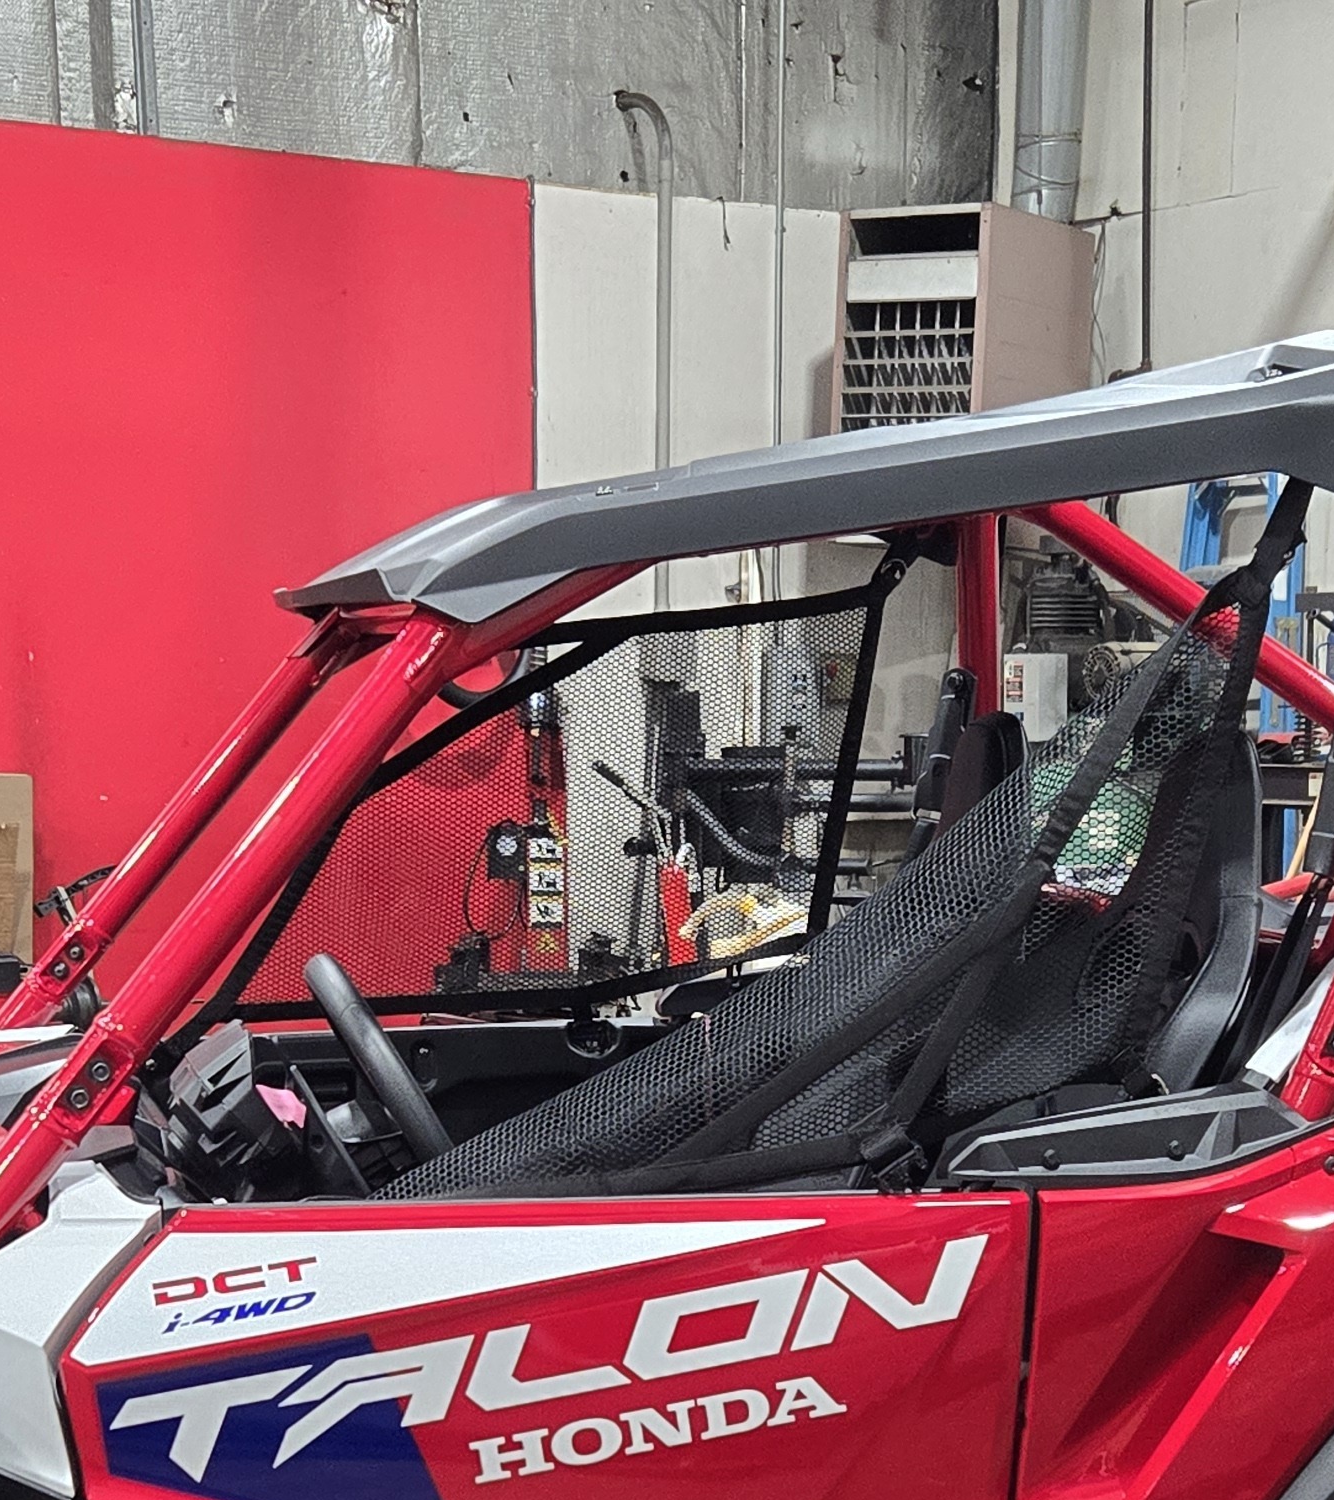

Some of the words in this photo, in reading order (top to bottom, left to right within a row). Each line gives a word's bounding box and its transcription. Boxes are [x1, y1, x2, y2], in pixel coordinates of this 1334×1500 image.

[152, 1256, 317, 1306] DCT
[161, 1291, 317, 1335] i-4WD
[110, 1233, 990, 1484] TALON
[467, 1375, 847, 1485] HONDA
